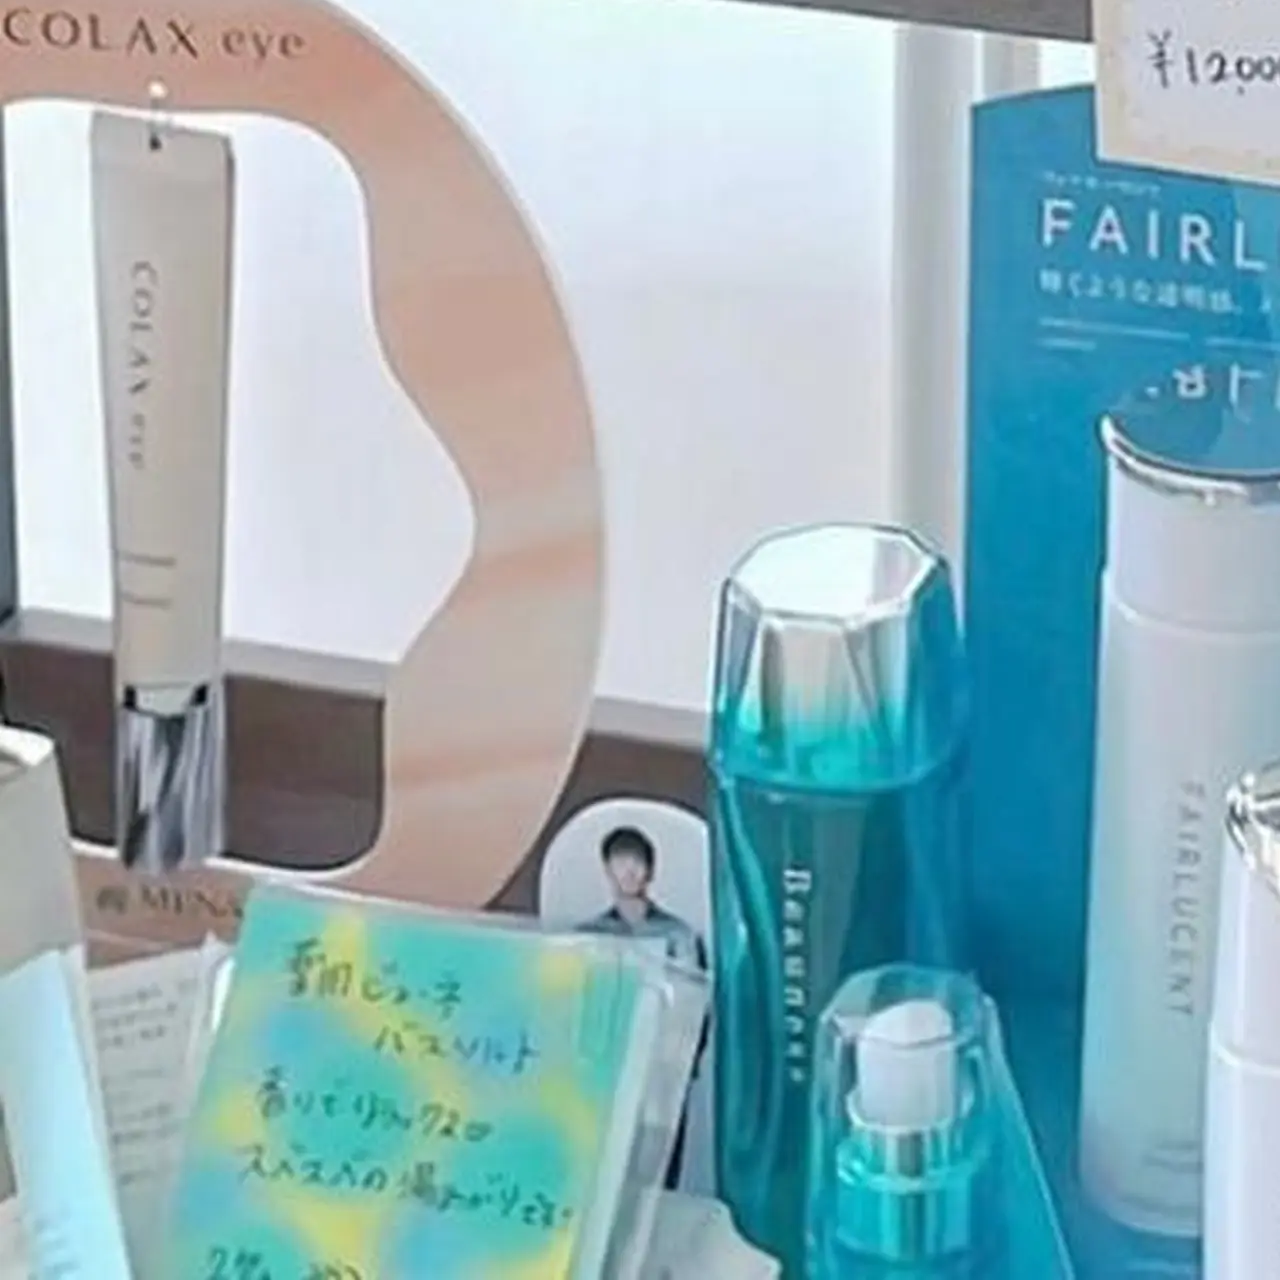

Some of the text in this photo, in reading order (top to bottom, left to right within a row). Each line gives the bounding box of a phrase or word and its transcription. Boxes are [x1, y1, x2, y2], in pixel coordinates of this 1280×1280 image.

[2, 6, 307, 62] COLAX eye
[126, 259, 159, 398] COLAX
[1163, 780, 1208, 1021] FAIRLUCENT
